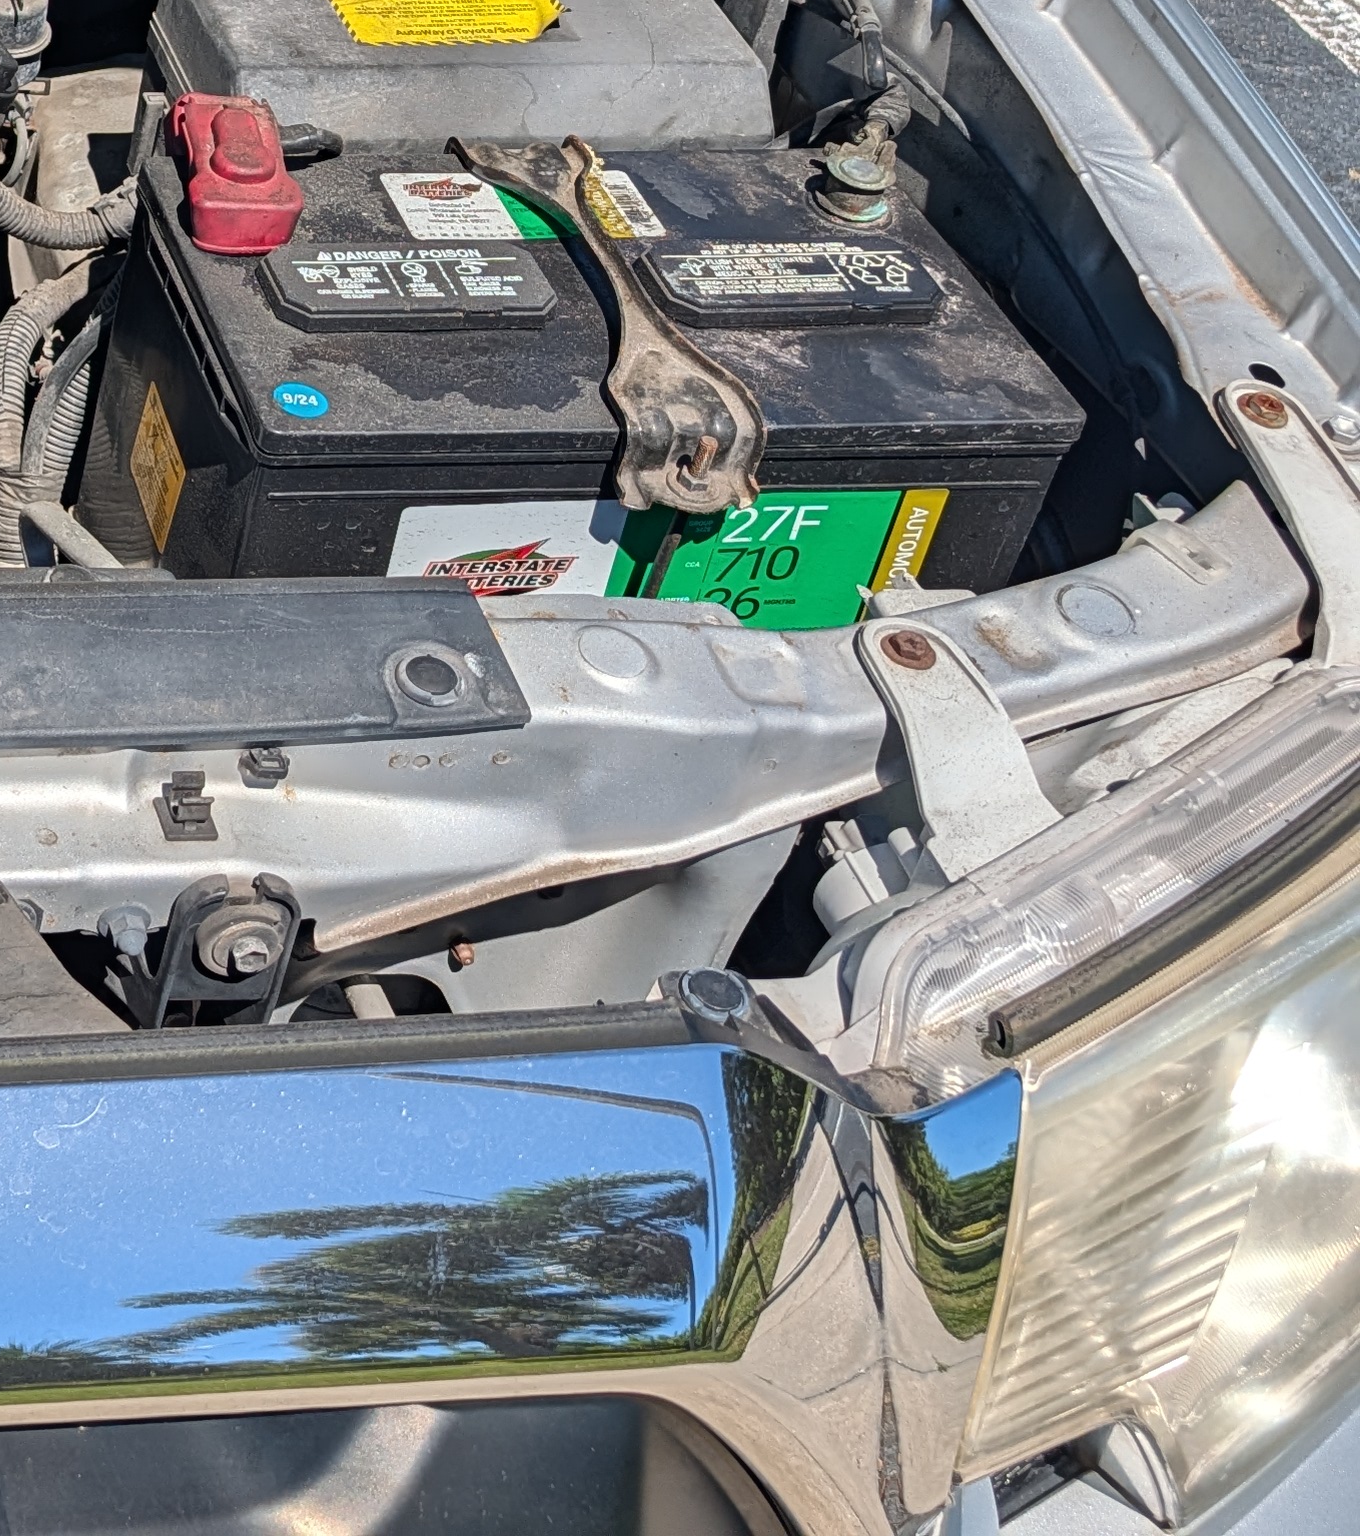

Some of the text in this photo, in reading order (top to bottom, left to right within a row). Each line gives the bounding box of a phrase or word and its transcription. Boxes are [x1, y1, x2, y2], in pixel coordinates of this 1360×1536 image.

[333, 249, 482, 261] DANGER / POISON
[759, 256, 814, 264] IMMEDIATELY
[282, 393, 318, 407] 9/24
[721, 505, 829, 543] 27F
[429, 558, 568, 576] INTERSTATE
[715, 546, 800, 583] 710
